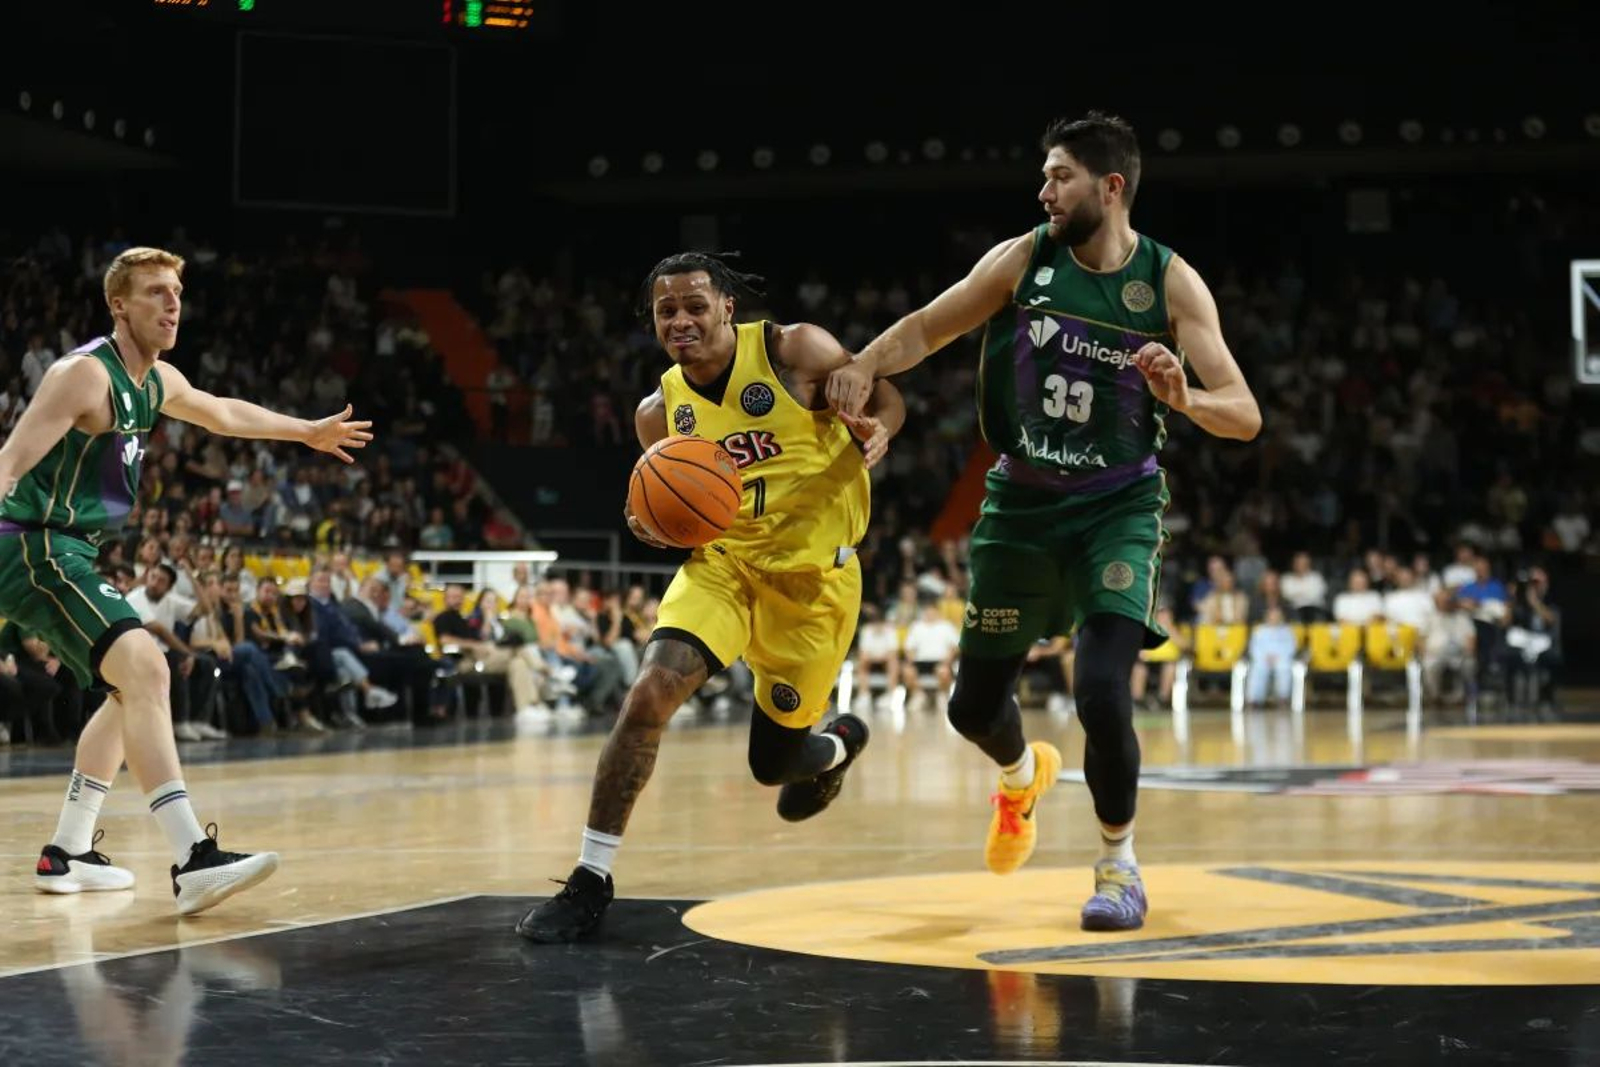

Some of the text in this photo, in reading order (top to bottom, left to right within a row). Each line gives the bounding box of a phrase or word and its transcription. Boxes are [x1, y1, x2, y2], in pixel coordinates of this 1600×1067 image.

[1043, 374, 1094, 424] 33
[717, 430, 782, 469] SK
[1016, 425, 1108, 468] Andalucía
[742, 476, 766, 518] 7
[982, 618, 1000, 626] DEL
[983, 608, 1020, 617] COSTA
